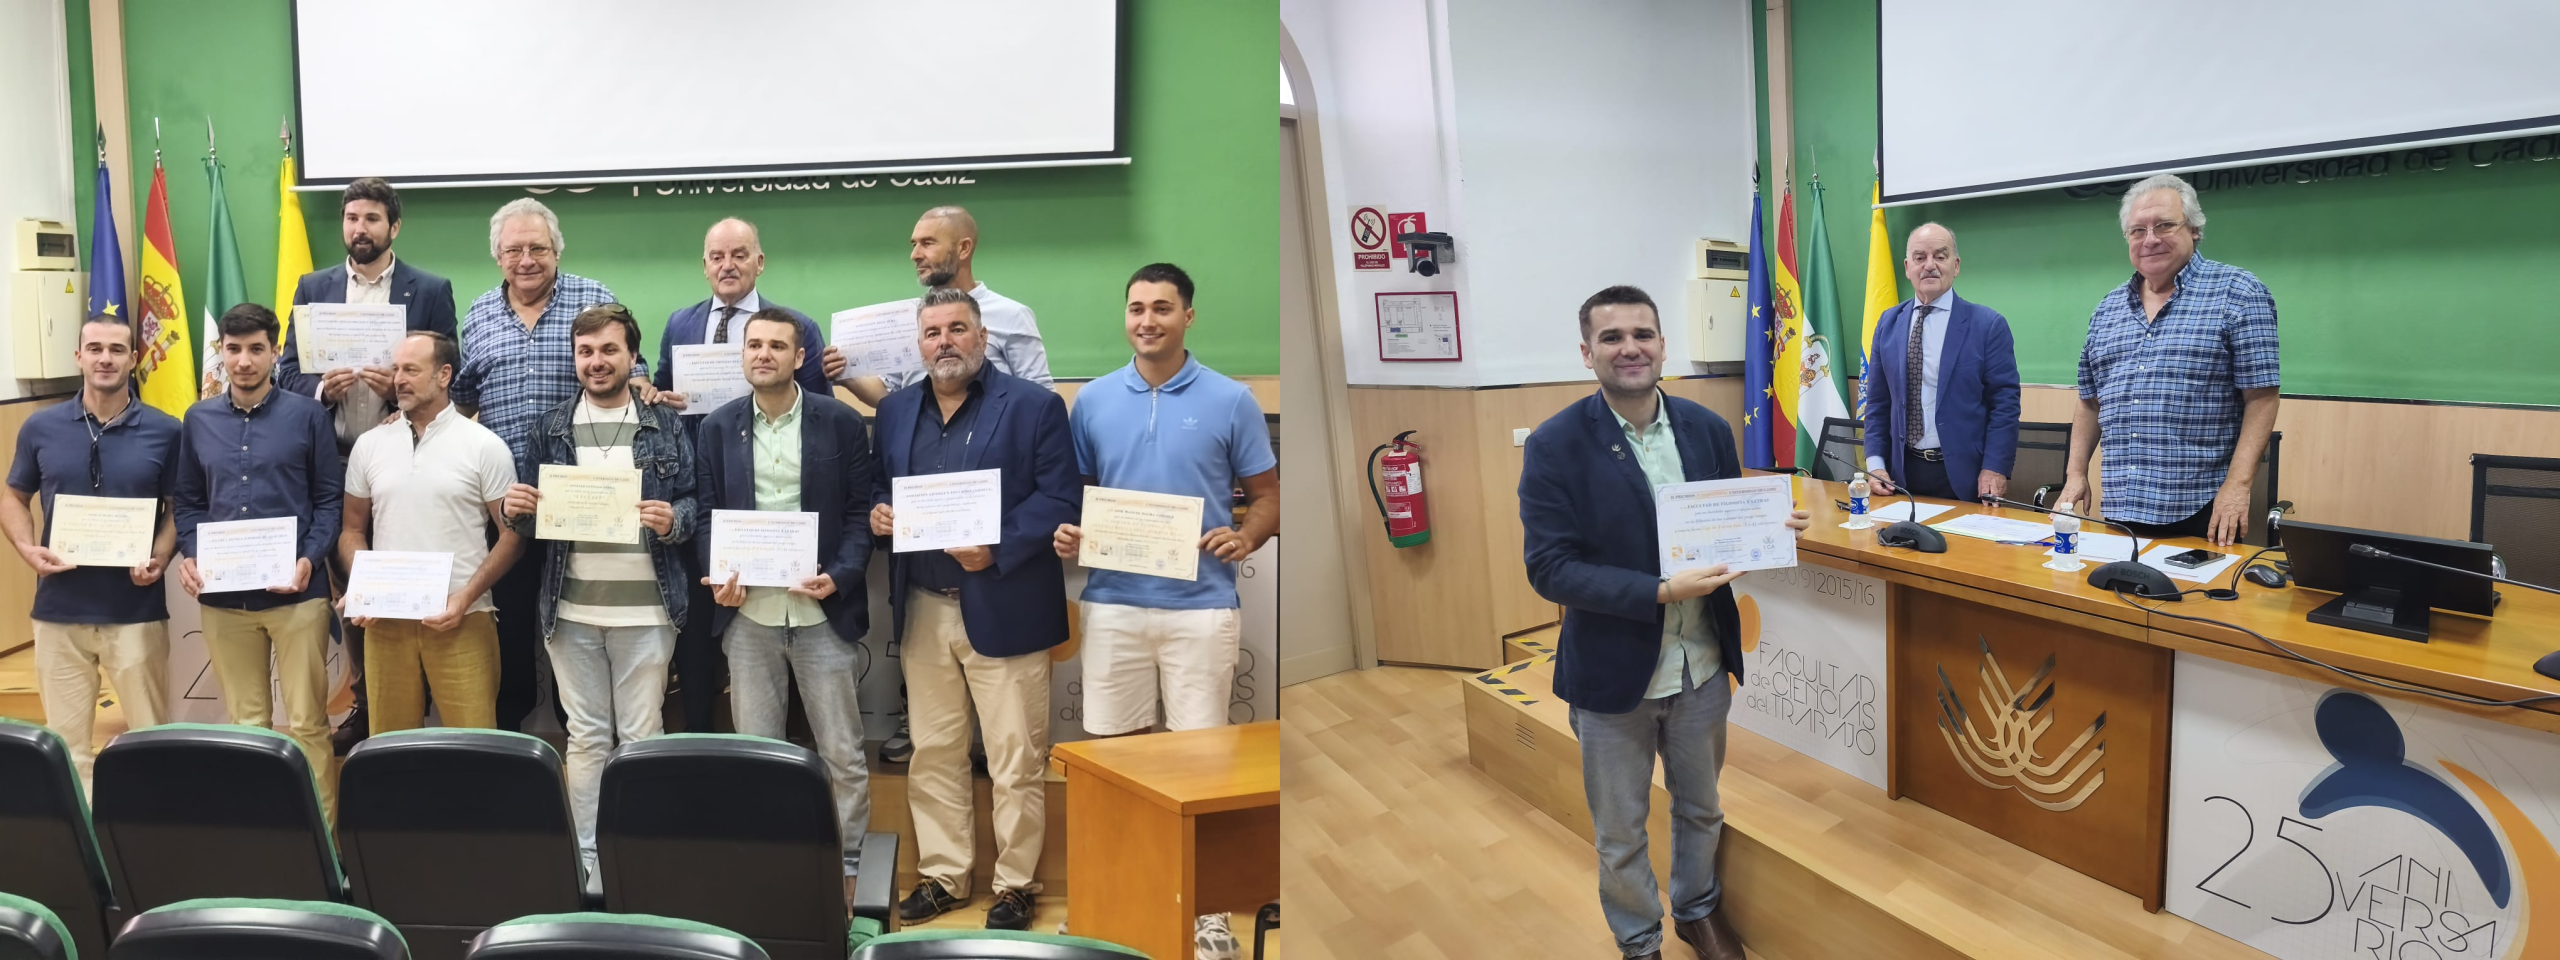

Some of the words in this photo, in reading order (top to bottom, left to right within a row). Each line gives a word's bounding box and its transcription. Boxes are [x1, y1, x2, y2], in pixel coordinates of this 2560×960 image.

[2120, 568, 2151, 581] BOSCH
[1759, 640, 1876, 704] FACULTAD
[1772, 671, 1876, 731] CIENCIAS
[2196, 795, 2335, 925] 25
[2358, 854, 2452, 909] ANI
